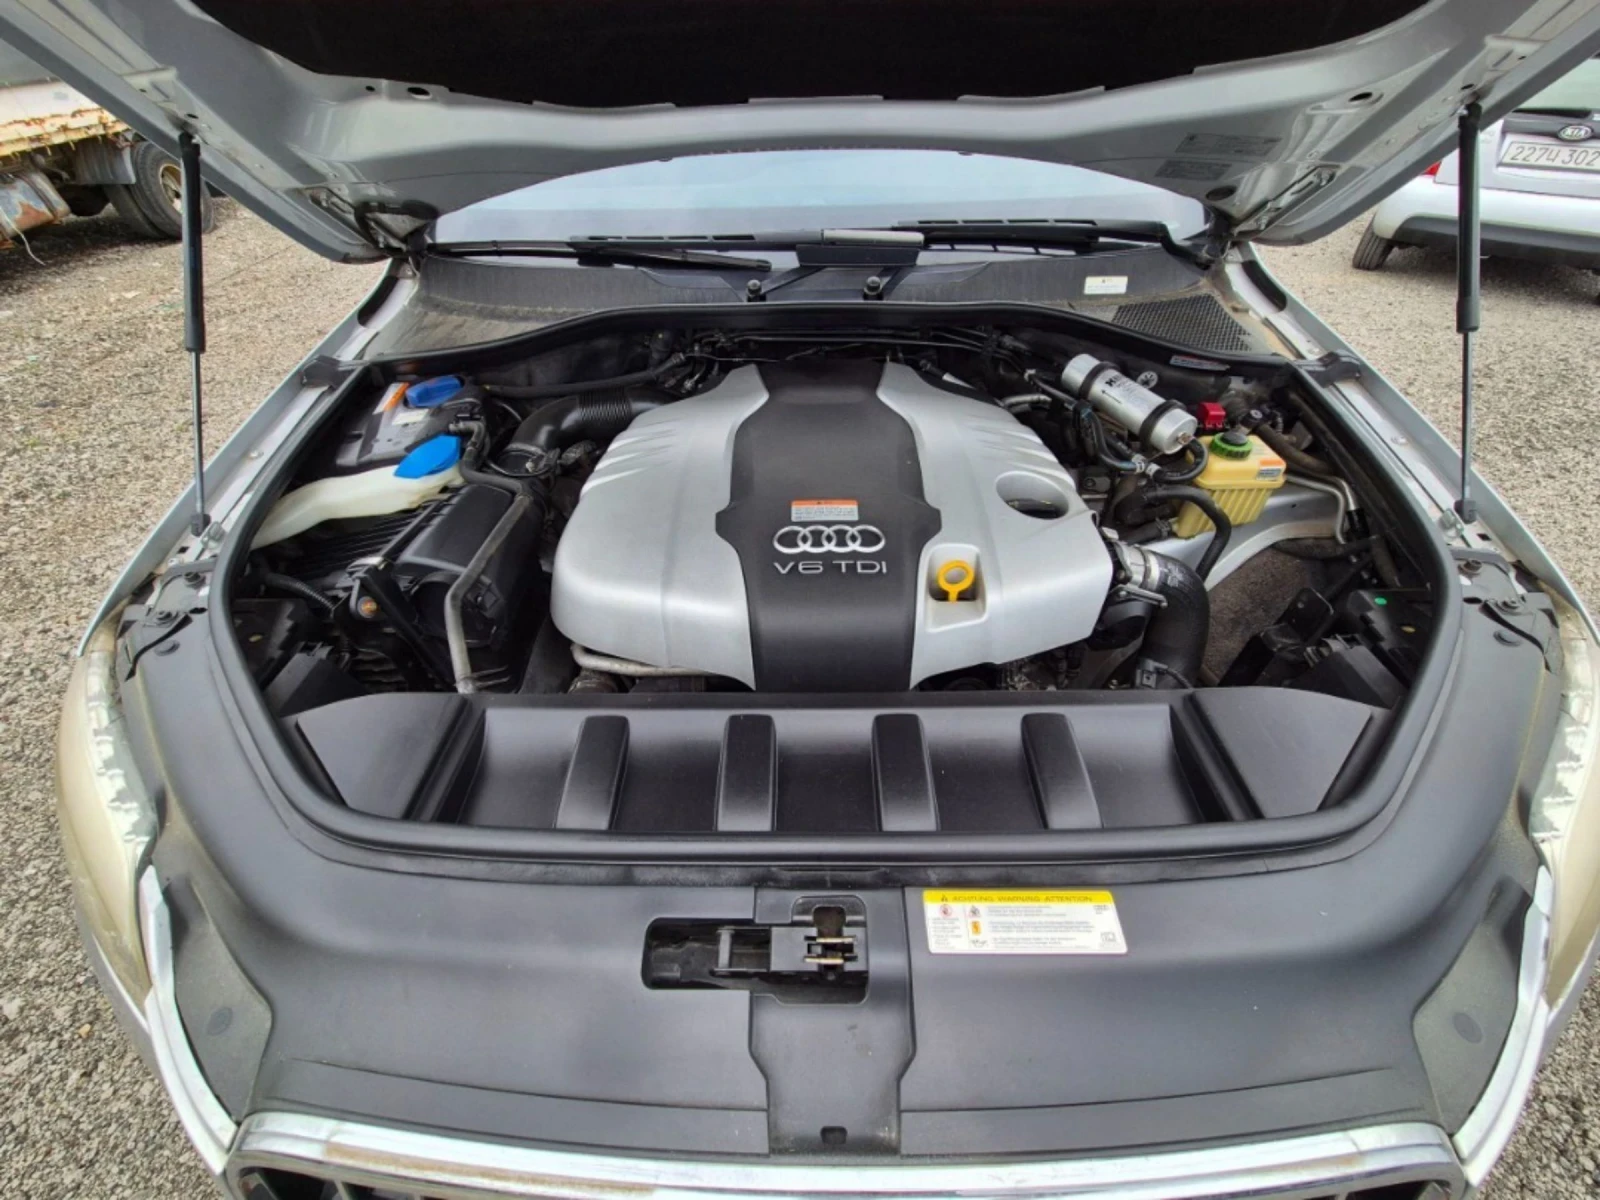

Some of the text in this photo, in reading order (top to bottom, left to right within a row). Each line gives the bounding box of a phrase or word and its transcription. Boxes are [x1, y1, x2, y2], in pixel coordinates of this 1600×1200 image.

[773, 560, 887, 574] V6 TDI
[952, 895, 1093, 903] ACHTUNG WARNING ATTENTION
